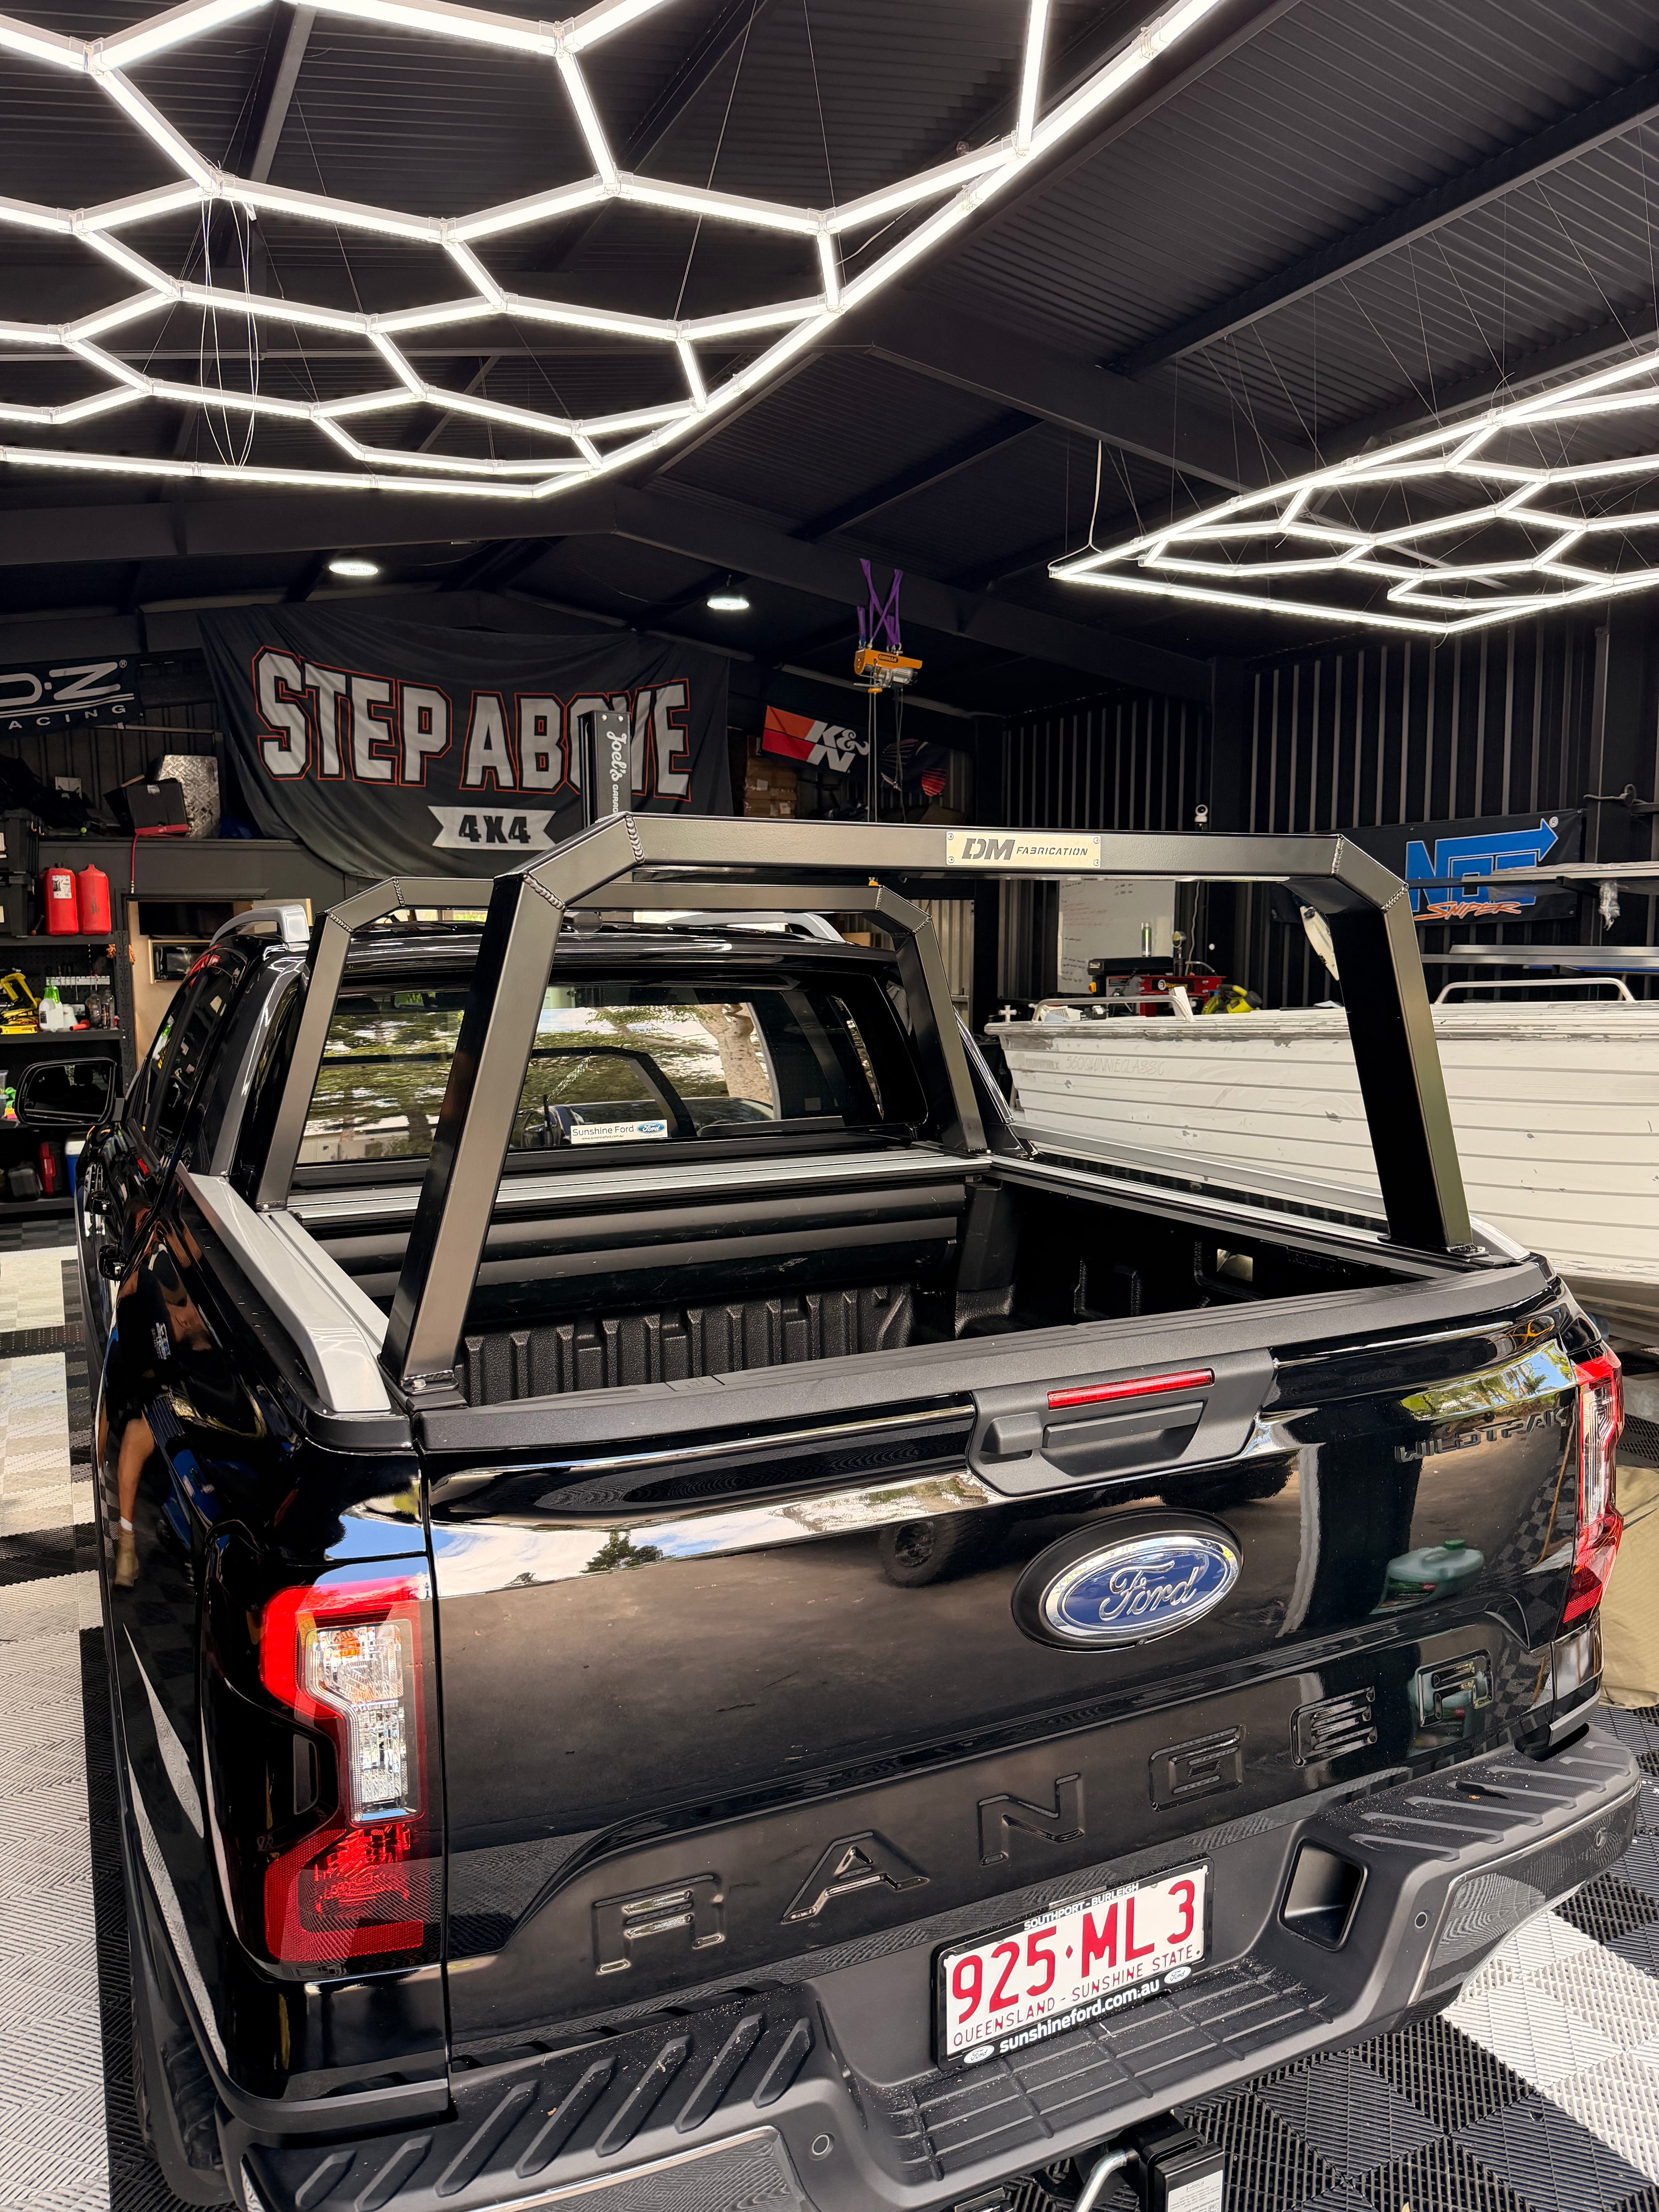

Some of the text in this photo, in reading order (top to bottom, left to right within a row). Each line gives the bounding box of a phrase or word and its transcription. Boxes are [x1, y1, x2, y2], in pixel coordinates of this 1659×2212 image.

[8, 705, 126, 730] ACING
[252, 645, 452, 786] STEP
[607, 731, 627, 782] Joel's
[459, 814, 531, 844] 4X4
[962, 838, 1088, 861] DM FABRICATION
[1414, 901, 1522, 921] SNIPER
[572, 1125, 634, 1136] Sunshine Ford
[642, 1124, 660, 1132] Ford
[1394, 1407, 1567, 1463] WILDTRAK
[1098, 1560, 1199, 1622] Ford
[591, 1648, 1494, 1976] RANGER
[1024, 1901, 1085, 1931] SOUTHPORT
[1092, 1882, 1139, 1907] BURLEIGH
[953, 1997, 1055, 2047] QUEENSLAND
[1072, 1963, 1143, 2002] SUNSHINE
[1152, 1944, 1193, 1972] STATE
[970, 1970, 1185, 2061] Ford sunshineford.com.au Ford
